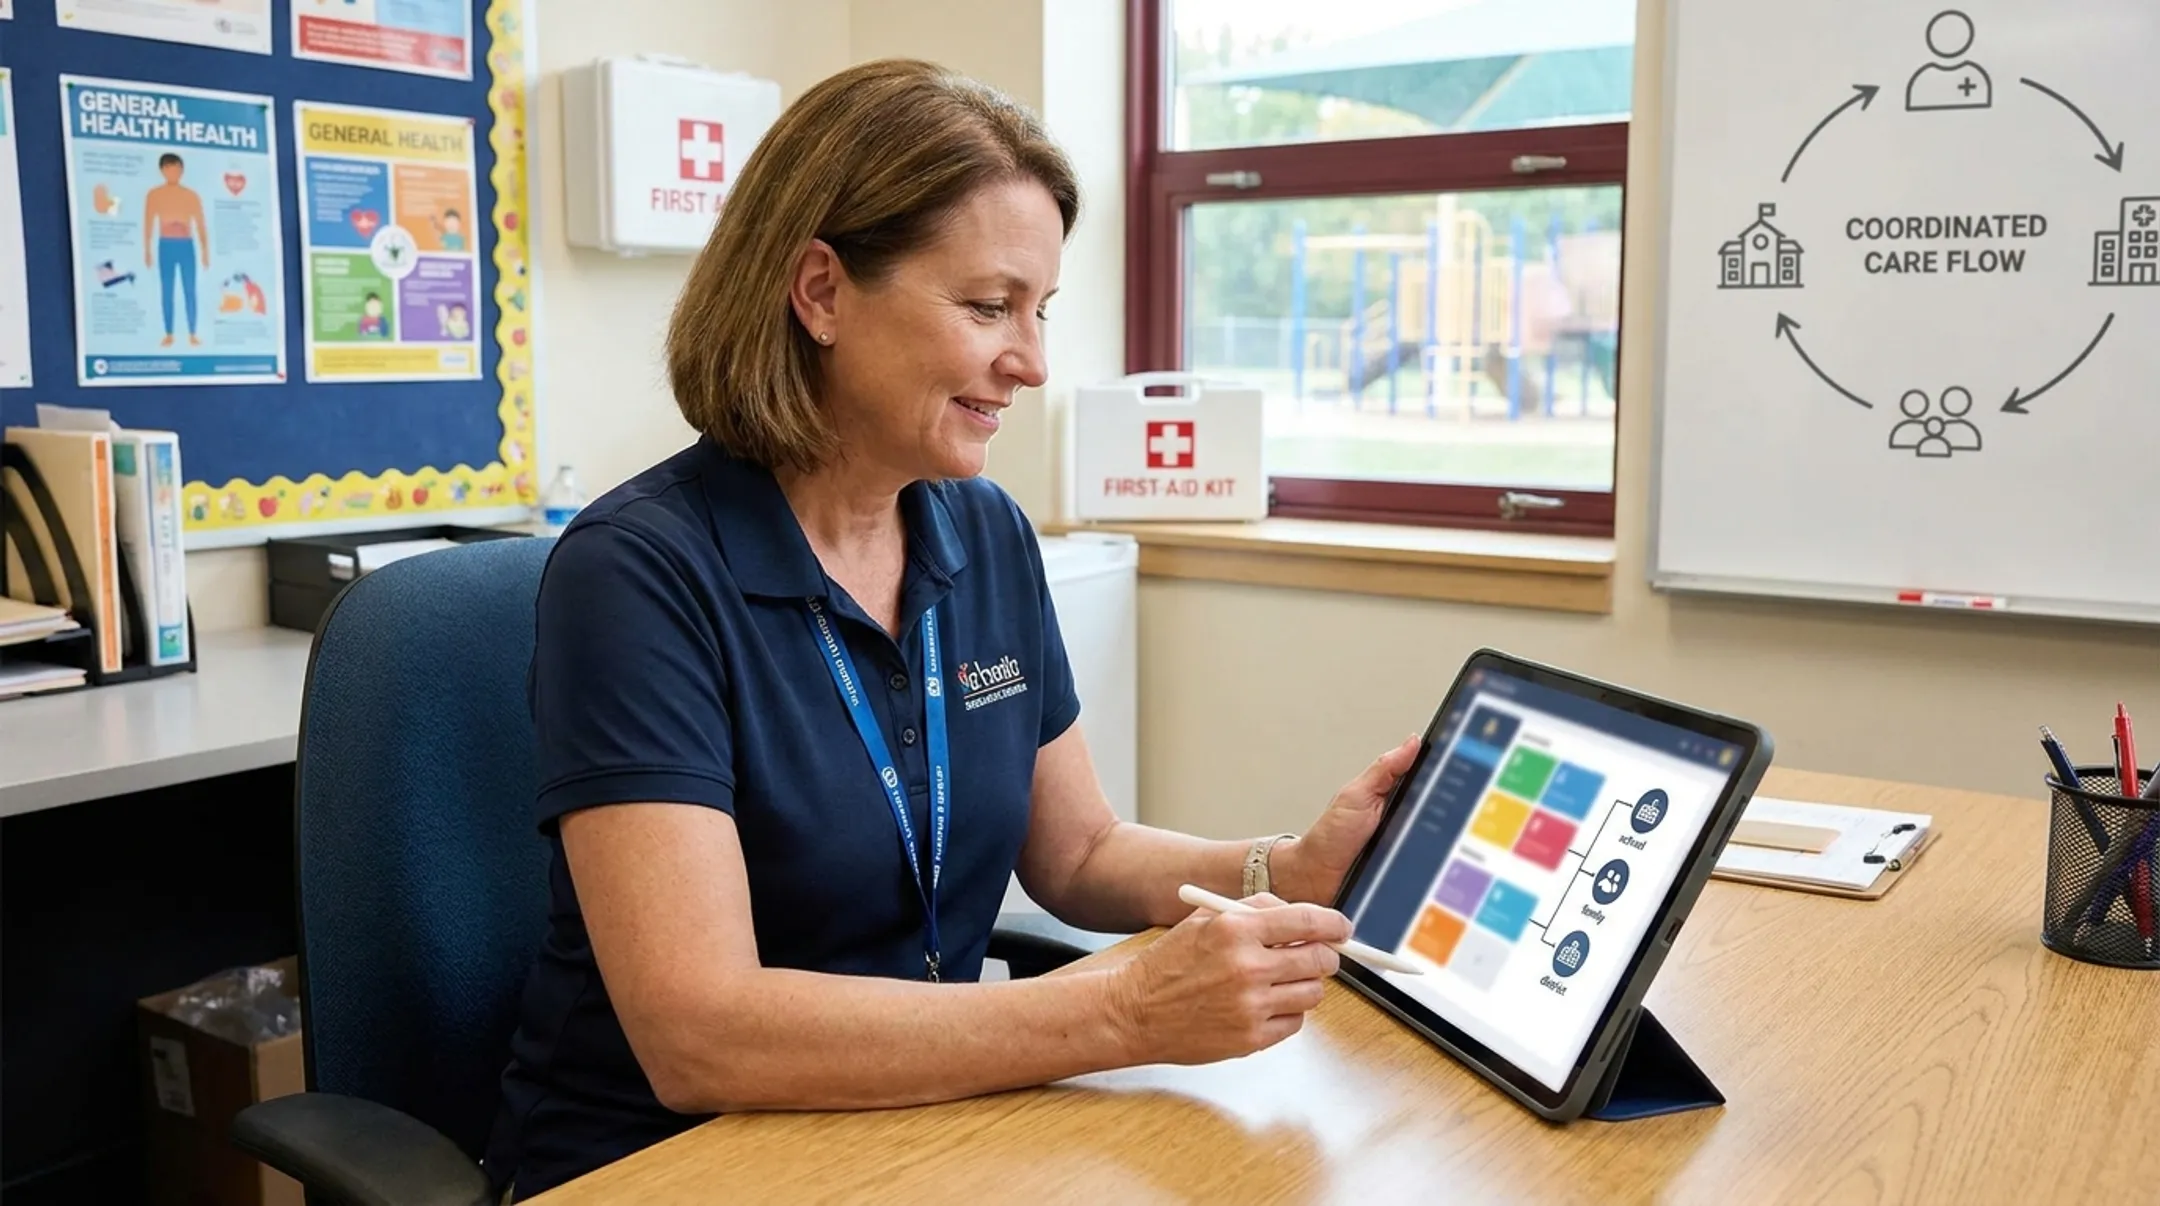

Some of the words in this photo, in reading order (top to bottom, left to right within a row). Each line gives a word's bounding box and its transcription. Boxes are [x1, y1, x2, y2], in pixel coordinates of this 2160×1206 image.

[79, 90, 184, 119] GENERAL
[80, 112, 170, 140] HEALTH
[175, 120, 257, 148] HEALTH
[309, 122, 393, 147] GENERAL
[398, 130, 463, 152] HEALTH
[651, 187, 706, 213] FIRST
[1845, 214, 2048, 241] COORDINATED
[1864, 250, 1938, 274] CARE
[1946, 249, 2026, 273] FLOW
[1205, 478, 1236, 496] KIT
